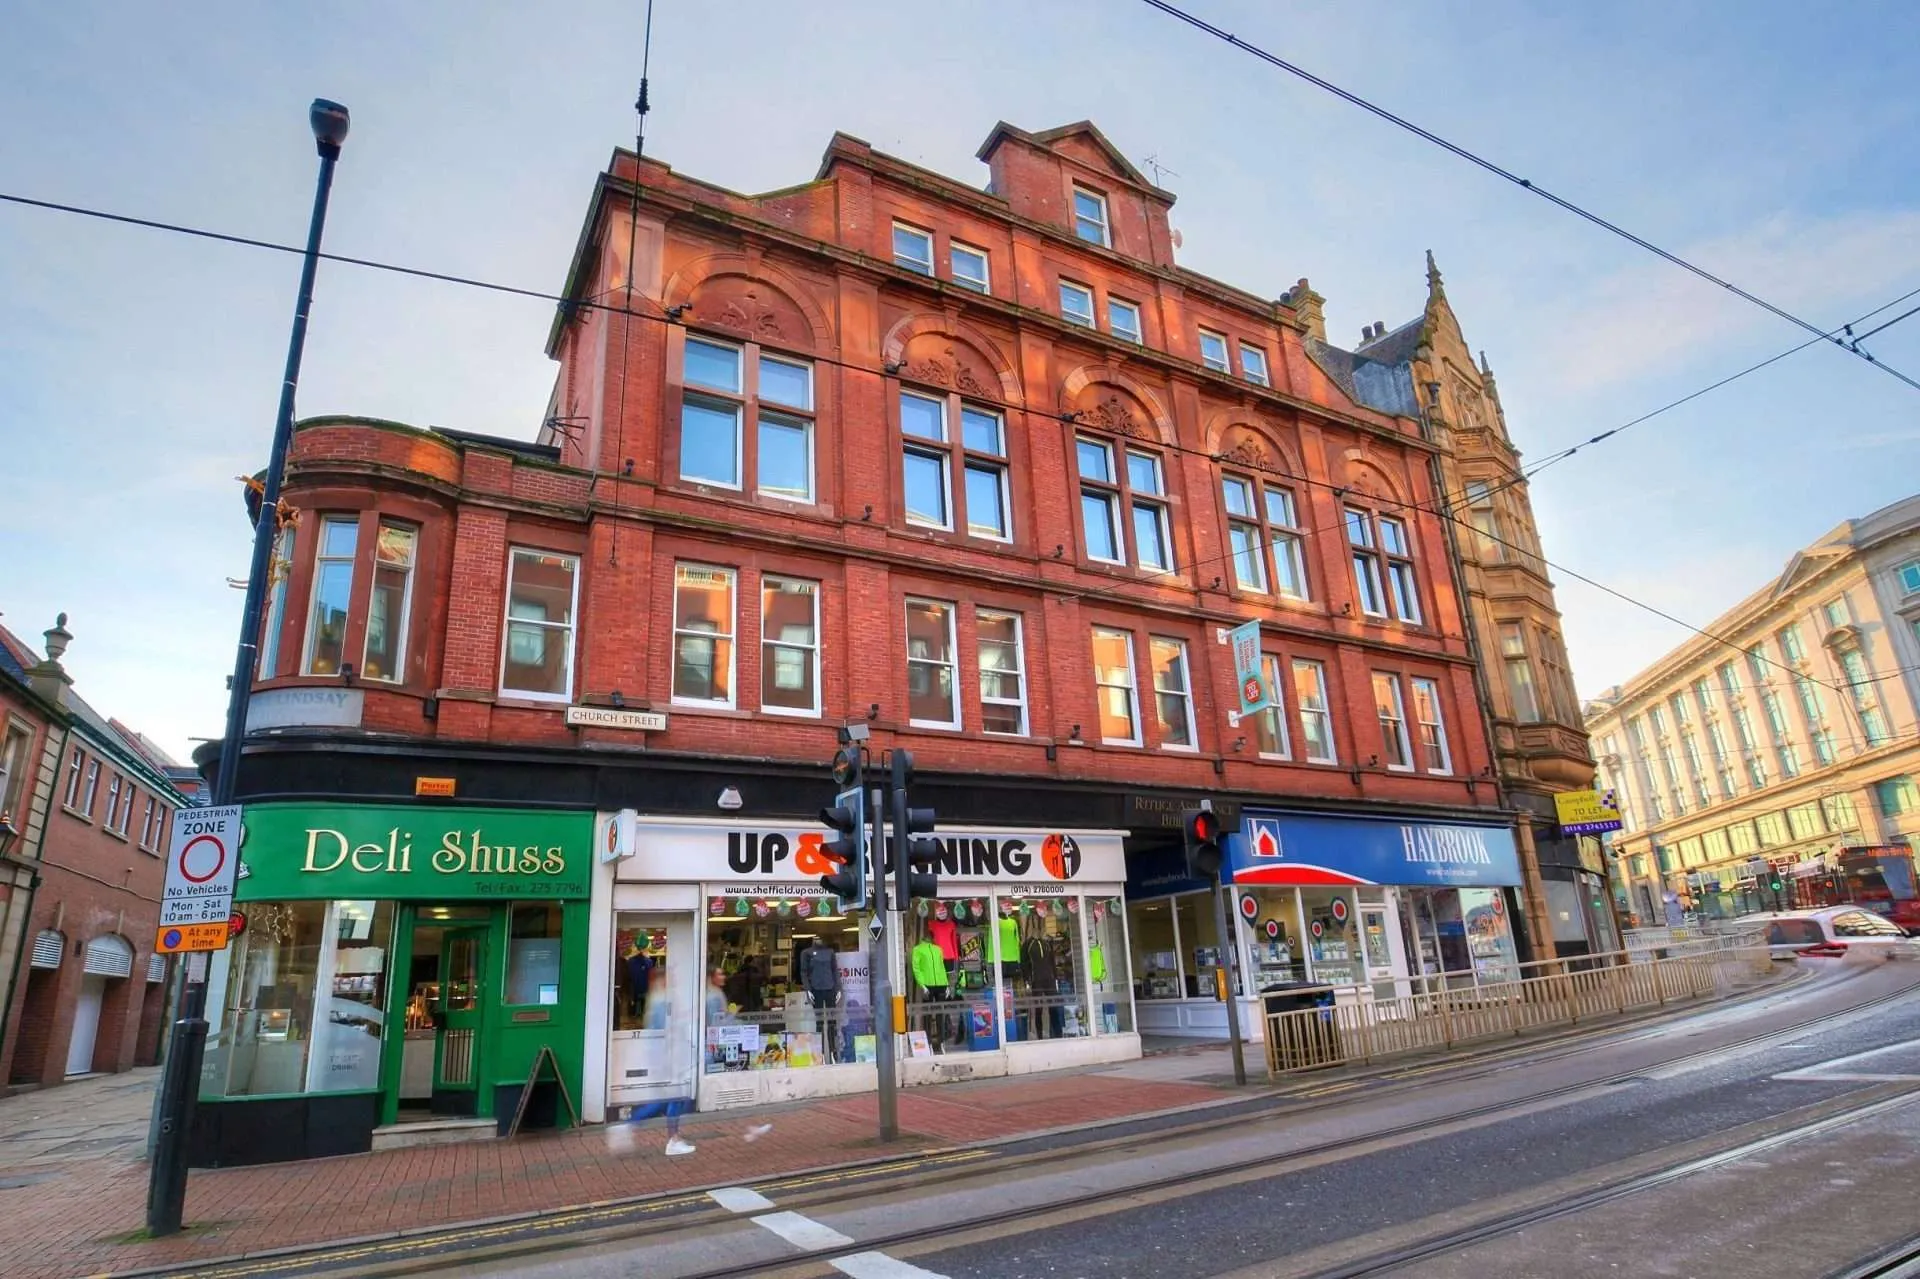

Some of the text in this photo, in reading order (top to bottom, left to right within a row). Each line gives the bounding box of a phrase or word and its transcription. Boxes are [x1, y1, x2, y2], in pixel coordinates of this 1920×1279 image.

[572, 711, 659, 726] CHURCH STREET
[178, 808, 238, 820] PEDESTRIAN
[1573, 806, 1603, 815] TO LET
[184, 821, 226, 835] ZONE
[300, 827, 566, 875] Deli Shuss
[1400, 826, 1491, 864] HAYBROOK
[728, 833, 790, 874] UP
[794, 833, 839, 876] &
[168, 884, 229, 897] No Vehicles
[1010, 884, 1031, 896] (0114)
[171, 902, 193, 911] Mon
[203, 899, 221, 909] Sat
[188, 927, 222, 938] At any
[191, 938, 215, 949] time
